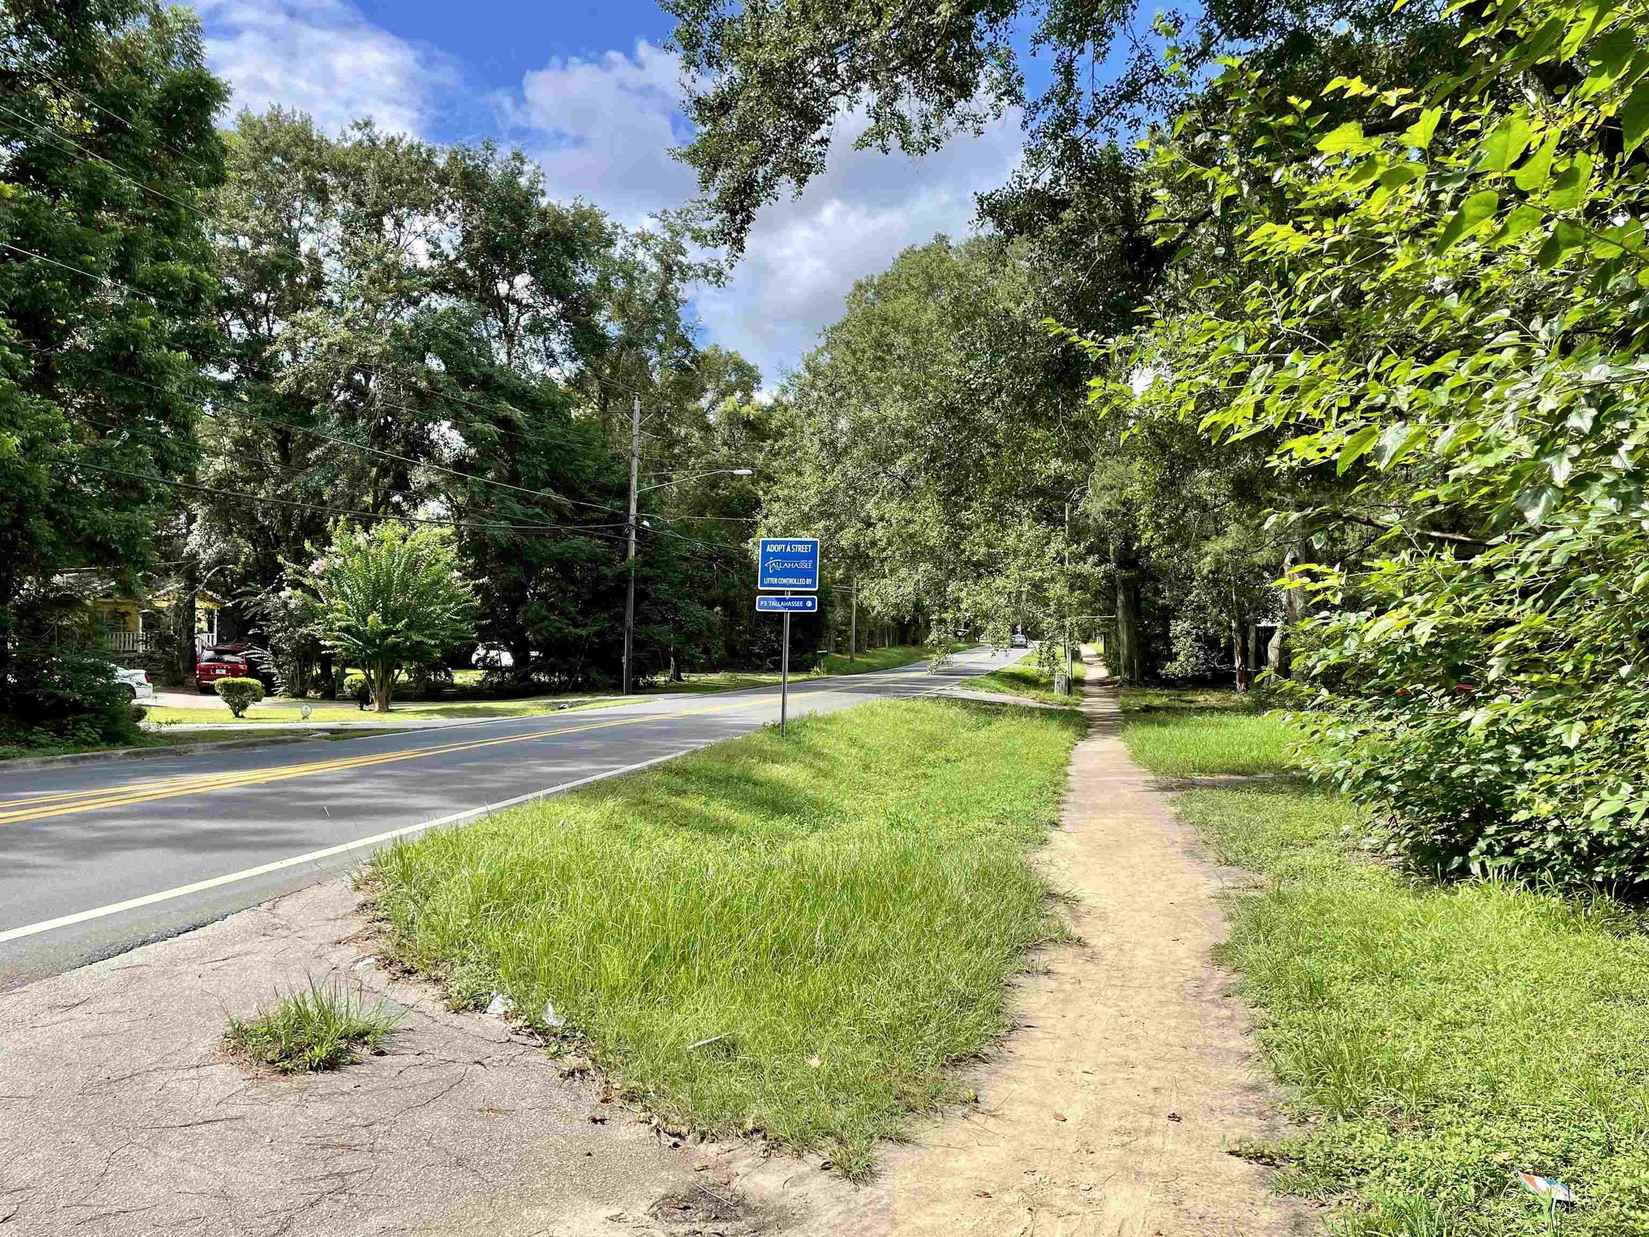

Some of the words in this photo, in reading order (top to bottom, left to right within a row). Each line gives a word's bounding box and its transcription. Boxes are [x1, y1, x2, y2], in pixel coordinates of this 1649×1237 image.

[766, 544, 785, 552] ADOPT
[786, 544, 791, 552] A
[764, 558, 813, 573] TALLAHASSEE
